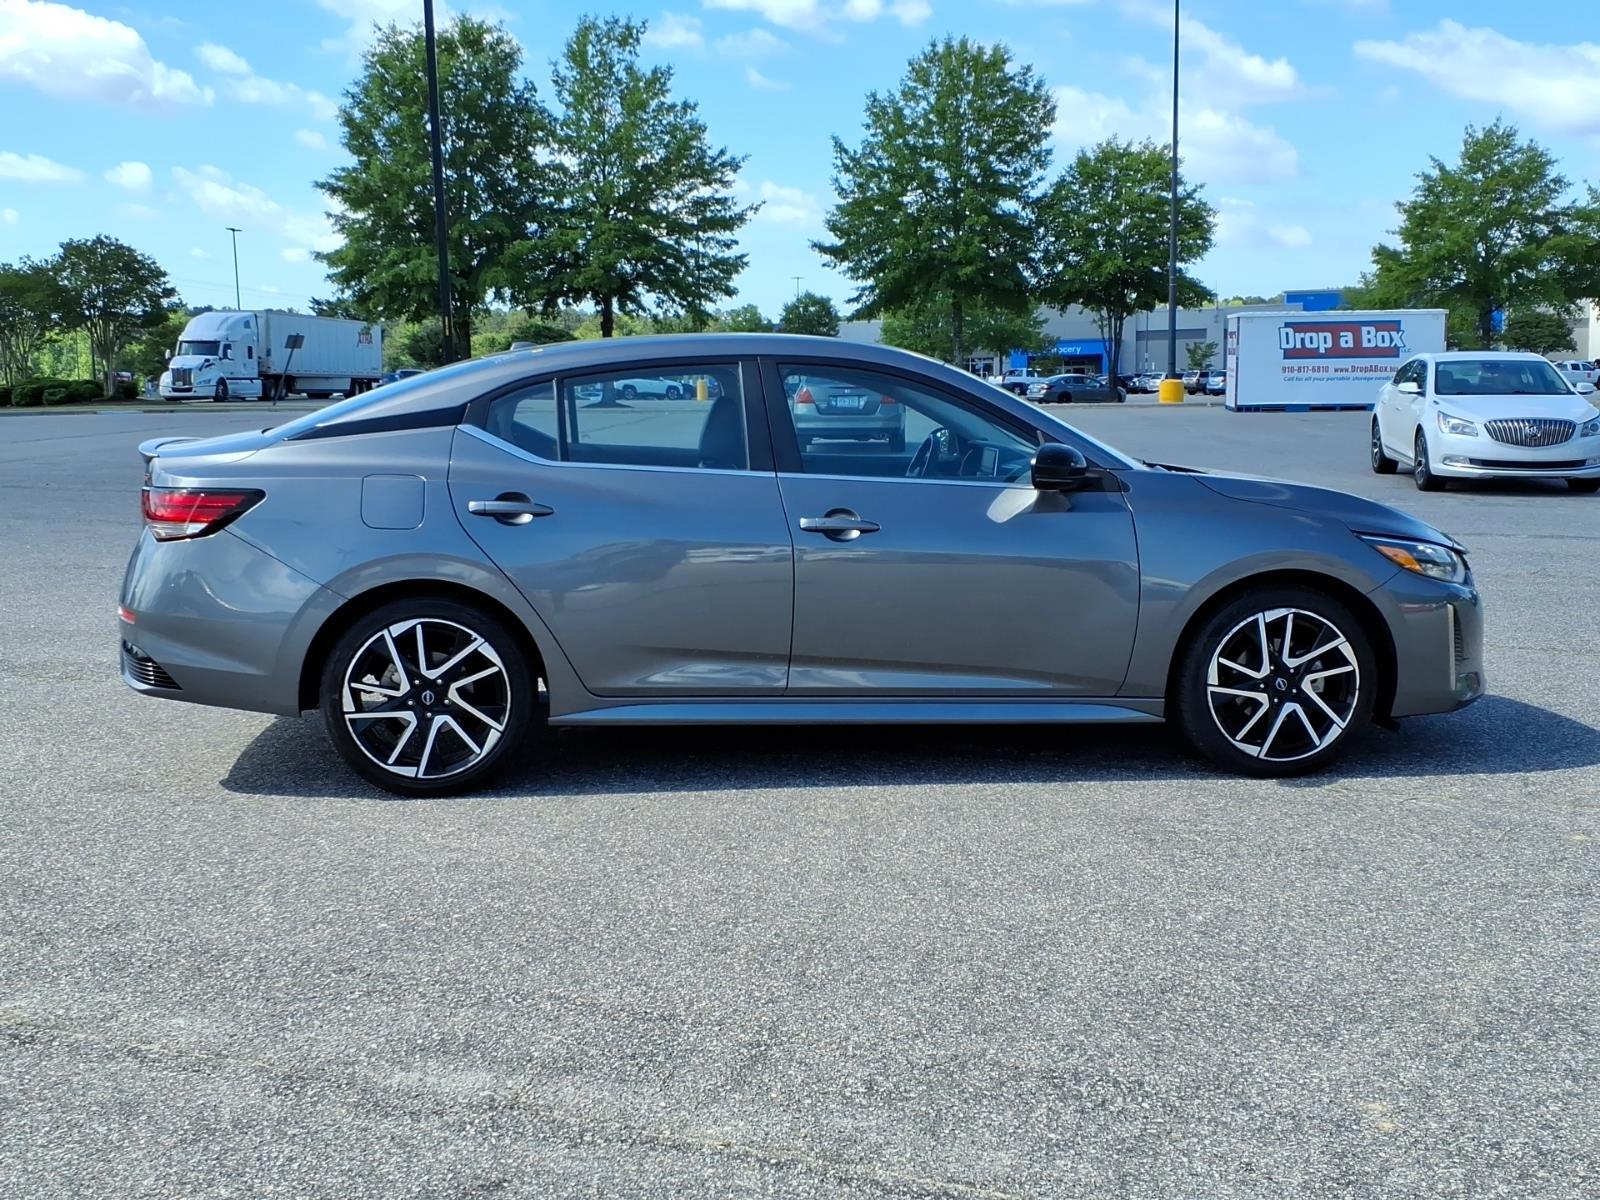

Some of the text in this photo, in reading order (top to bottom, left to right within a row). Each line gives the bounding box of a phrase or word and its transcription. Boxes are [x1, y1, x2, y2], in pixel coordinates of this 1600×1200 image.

[1279, 326, 1405, 354] Drop a Box
